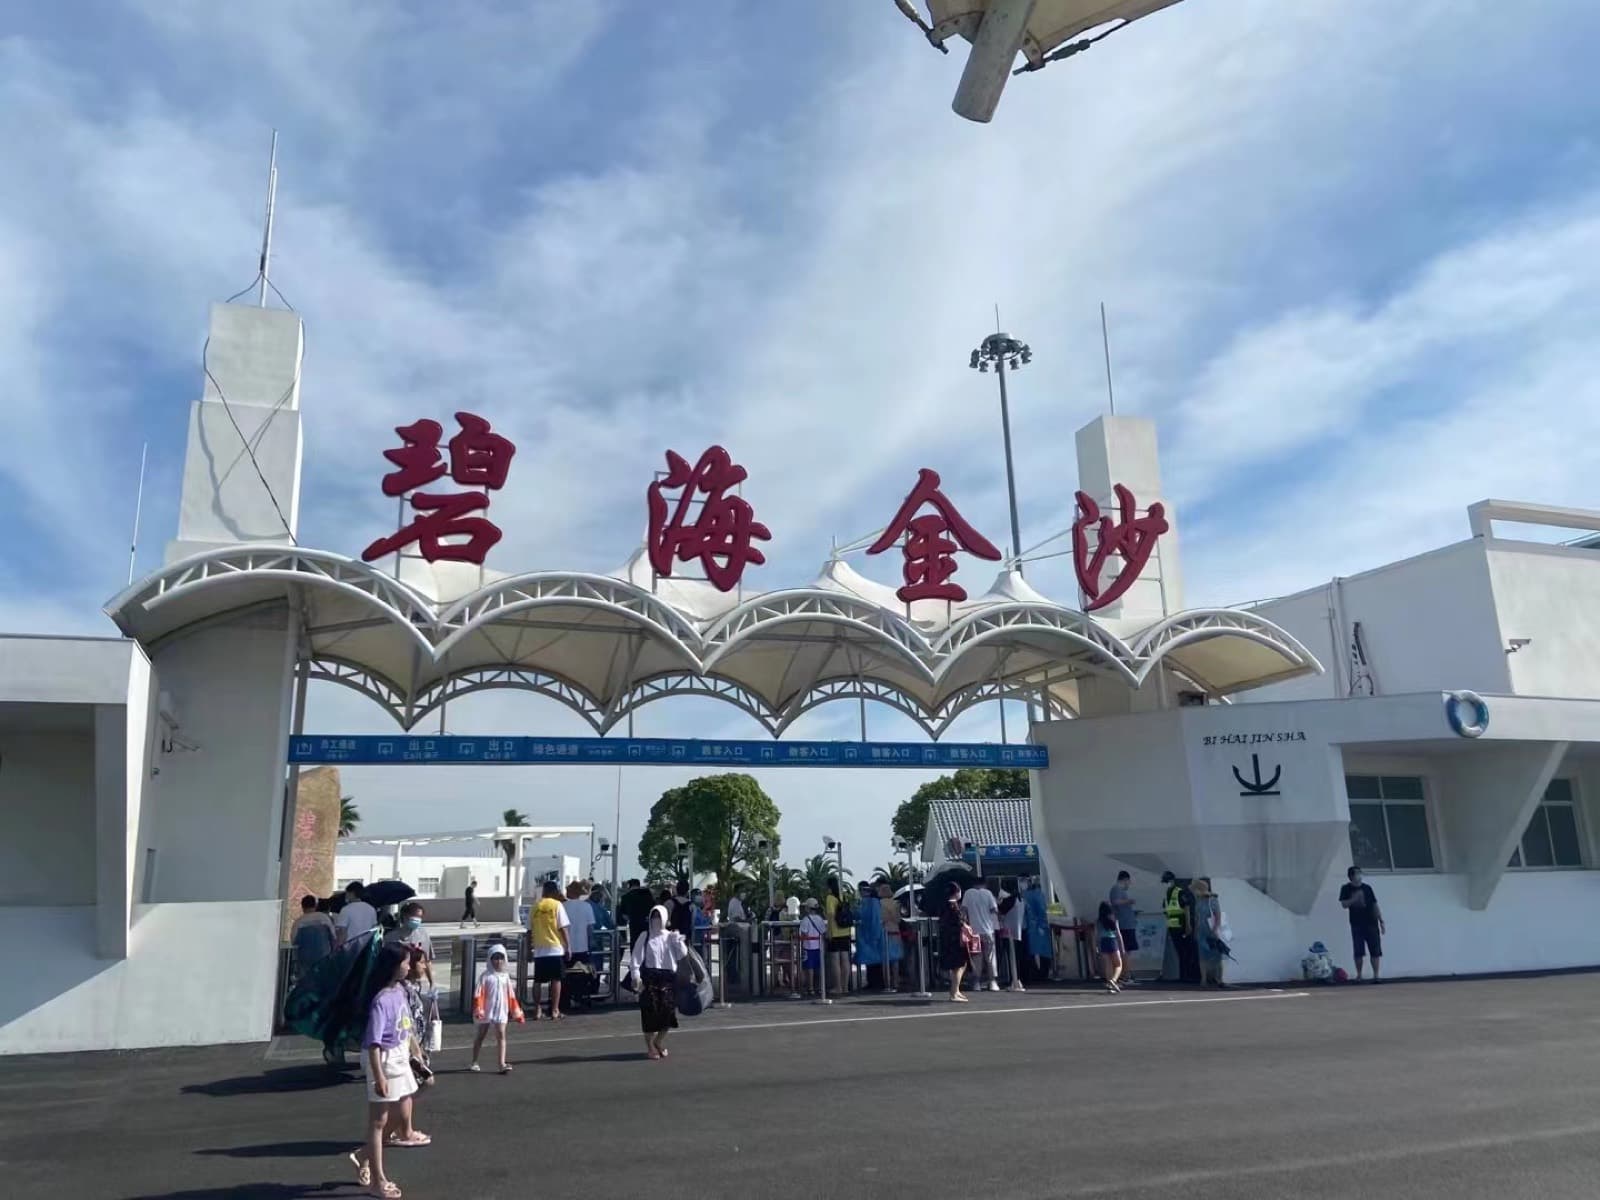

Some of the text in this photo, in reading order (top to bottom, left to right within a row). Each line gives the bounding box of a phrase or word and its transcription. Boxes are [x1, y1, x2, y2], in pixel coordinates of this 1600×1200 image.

[362, 411, 1169, 611] 碧海金沙
[1203, 731, 1307, 745] BI HAI JIN SHA
[409, 740, 435, 751] 出口
[489, 740, 513, 751] 出口
